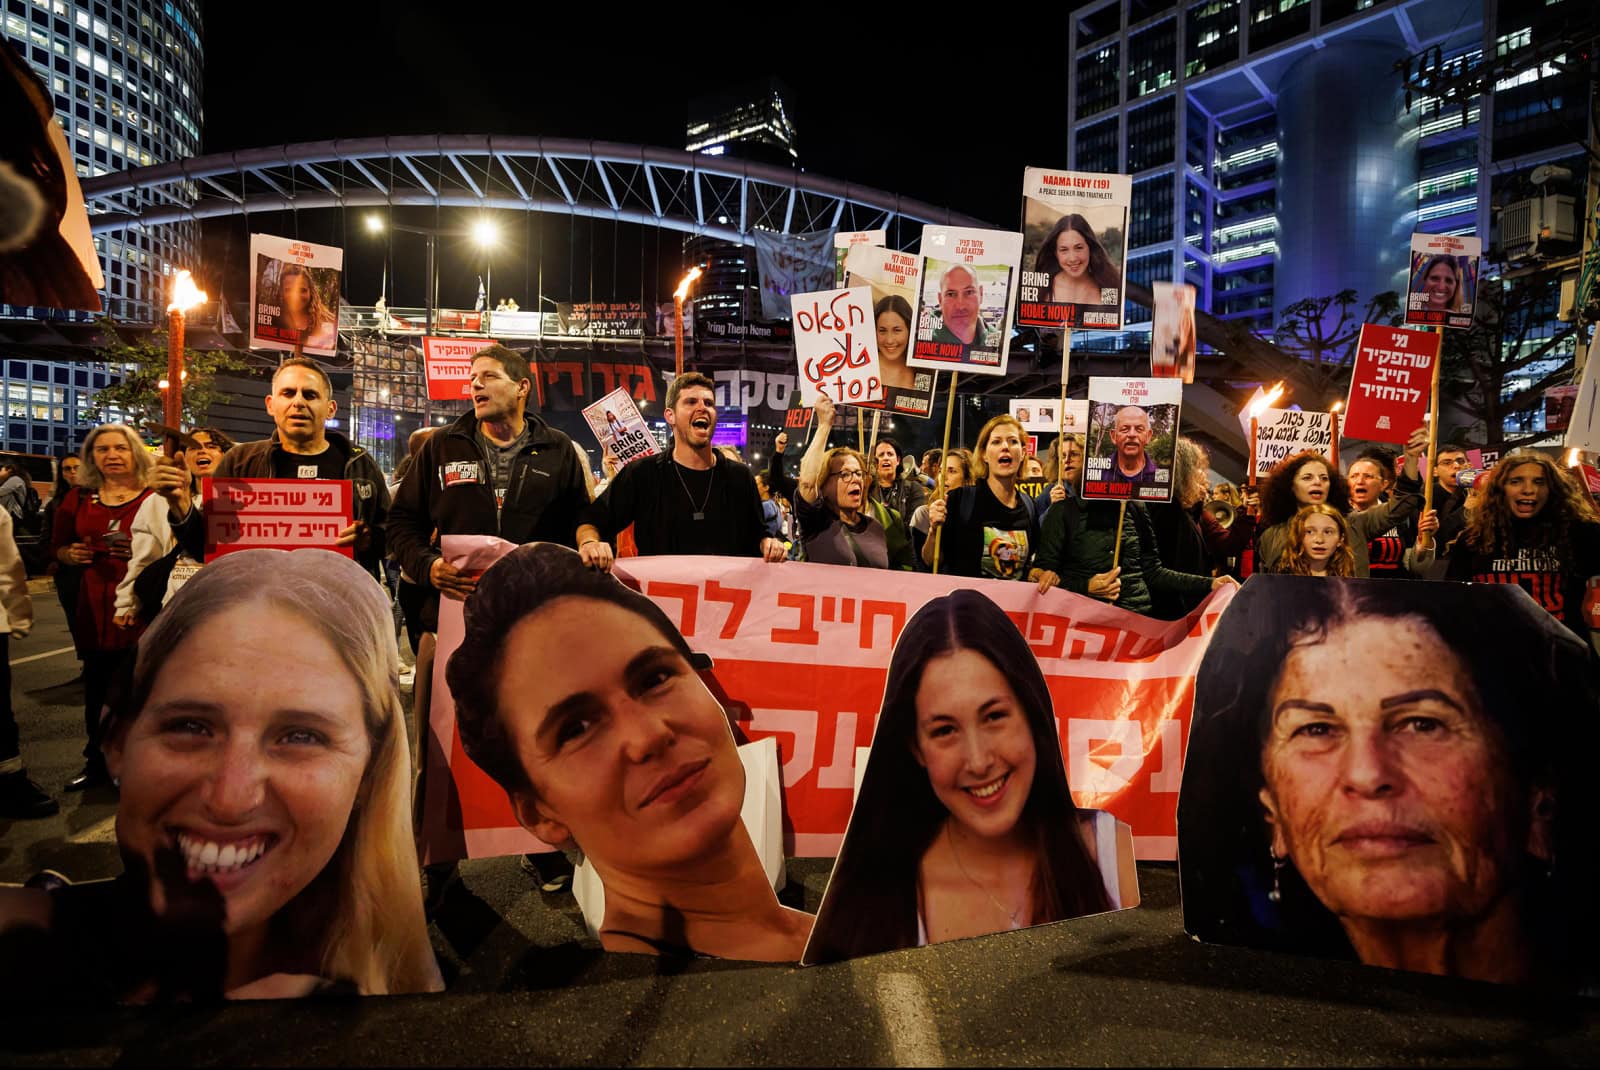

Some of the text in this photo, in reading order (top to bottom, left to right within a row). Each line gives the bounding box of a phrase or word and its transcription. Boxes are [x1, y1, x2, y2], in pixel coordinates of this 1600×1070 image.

[1043, 175, 1110, 189] NAAMA LEVY (19)
[1043, 188, 1057, 196] PEACE
[1057, 189, 1075, 197] SEEKER
[1086, 191, 1113, 199] TRIATHLETE
[884, 263, 919, 277] NAAMA LEVY
[1022, 271, 1050, 287] BRING
[1021, 287, 1039, 302] HER
[1410, 292, 1430, 302] BRING
[258, 304, 281, 317] BRING
[1020, 303, 1046, 318] HOME
[1047, 304, 1075, 321] NOW!
[1409, 301, 1422, 311] HER
[257, 314, 272, 326] HER
[610, 320, 627, 329] לירי
[919, 316, 944, 330] BRING
[727, 322, 749, 335] Them
[749, 323, 772, 337] Home
[917, 328, 934, 342] HIM
[1391, 333, 1409, 348] מי
[433, 344, 478, 356] שהפקיר
[916, 341, 938, 355] HOME
[939, 343, 963, 357] NOW!
[1362, 347, 1431, 369] שהפקיר
[432, 364, 472, 375] להחזיר
[1375, 367, 1410, 384] חייב
[529, 361, 585, 408] דין
[591, 362, 658, 402] גזר
[713, 368, 801, 415] סקה
[1360, 383, 1421, 403] להחזיר
[785, 408, 813, 428] HELP
[1275, 412, 1305, 427] זכות
[610, 430, 644, 454] BRING
[617, 440, 651, 462] HERSH
[1087, 457, 1112, 469] BRING
[1086, 468, 1102, 481] HIM
[1014, 481, 1049, 499] STA
[1086, 481, 1107, 493] HOME
[1109, 482, 1133, 495] NOW!
[221, 491, 306, 508] שהפקיר
[313, 491, 333, 506] מי
[215, 521, 339, 538] חייב להחזיר
[1491, 558, 1532, 572] הביתה
[770, 592, 907, 650] חייב
[1005, 610, 1166, 664] שהפ
